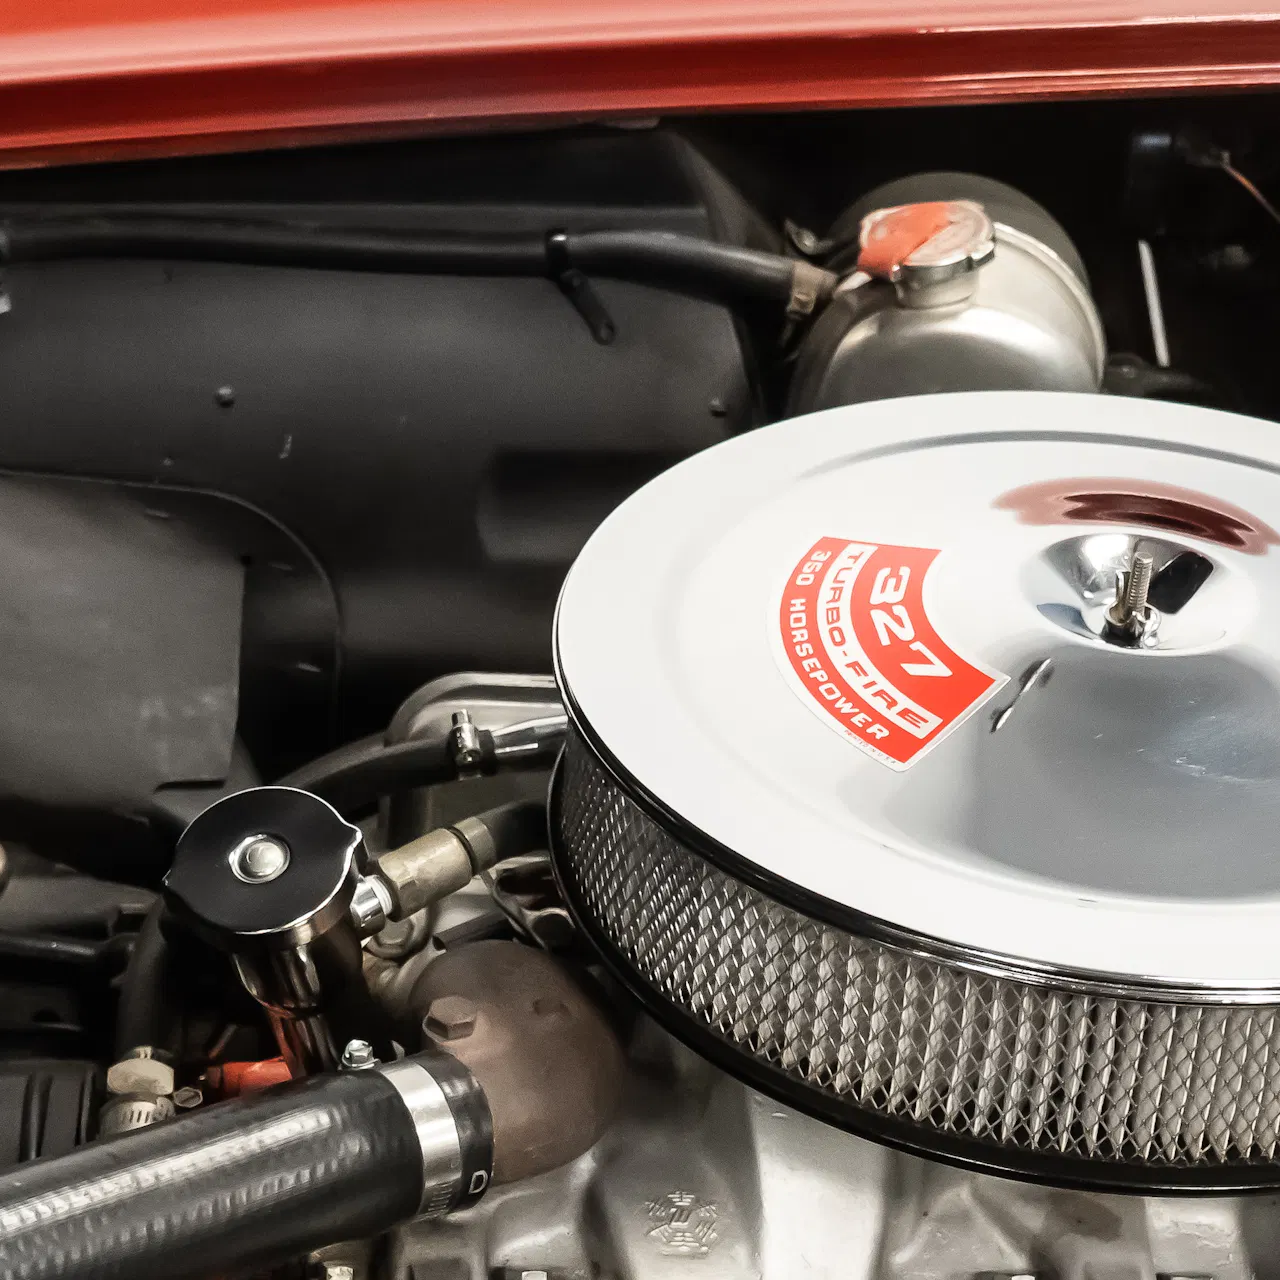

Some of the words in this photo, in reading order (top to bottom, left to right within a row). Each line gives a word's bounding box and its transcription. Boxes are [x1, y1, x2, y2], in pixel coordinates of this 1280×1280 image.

[796, 550, 832, 586] 350
[869, 566, 953, 677] 327
[789, 598, 890, 740] HORSEPOWER
[826, 550, 929, 729] TURBO-FIRE
[468, 1169, 489, 1195] D
